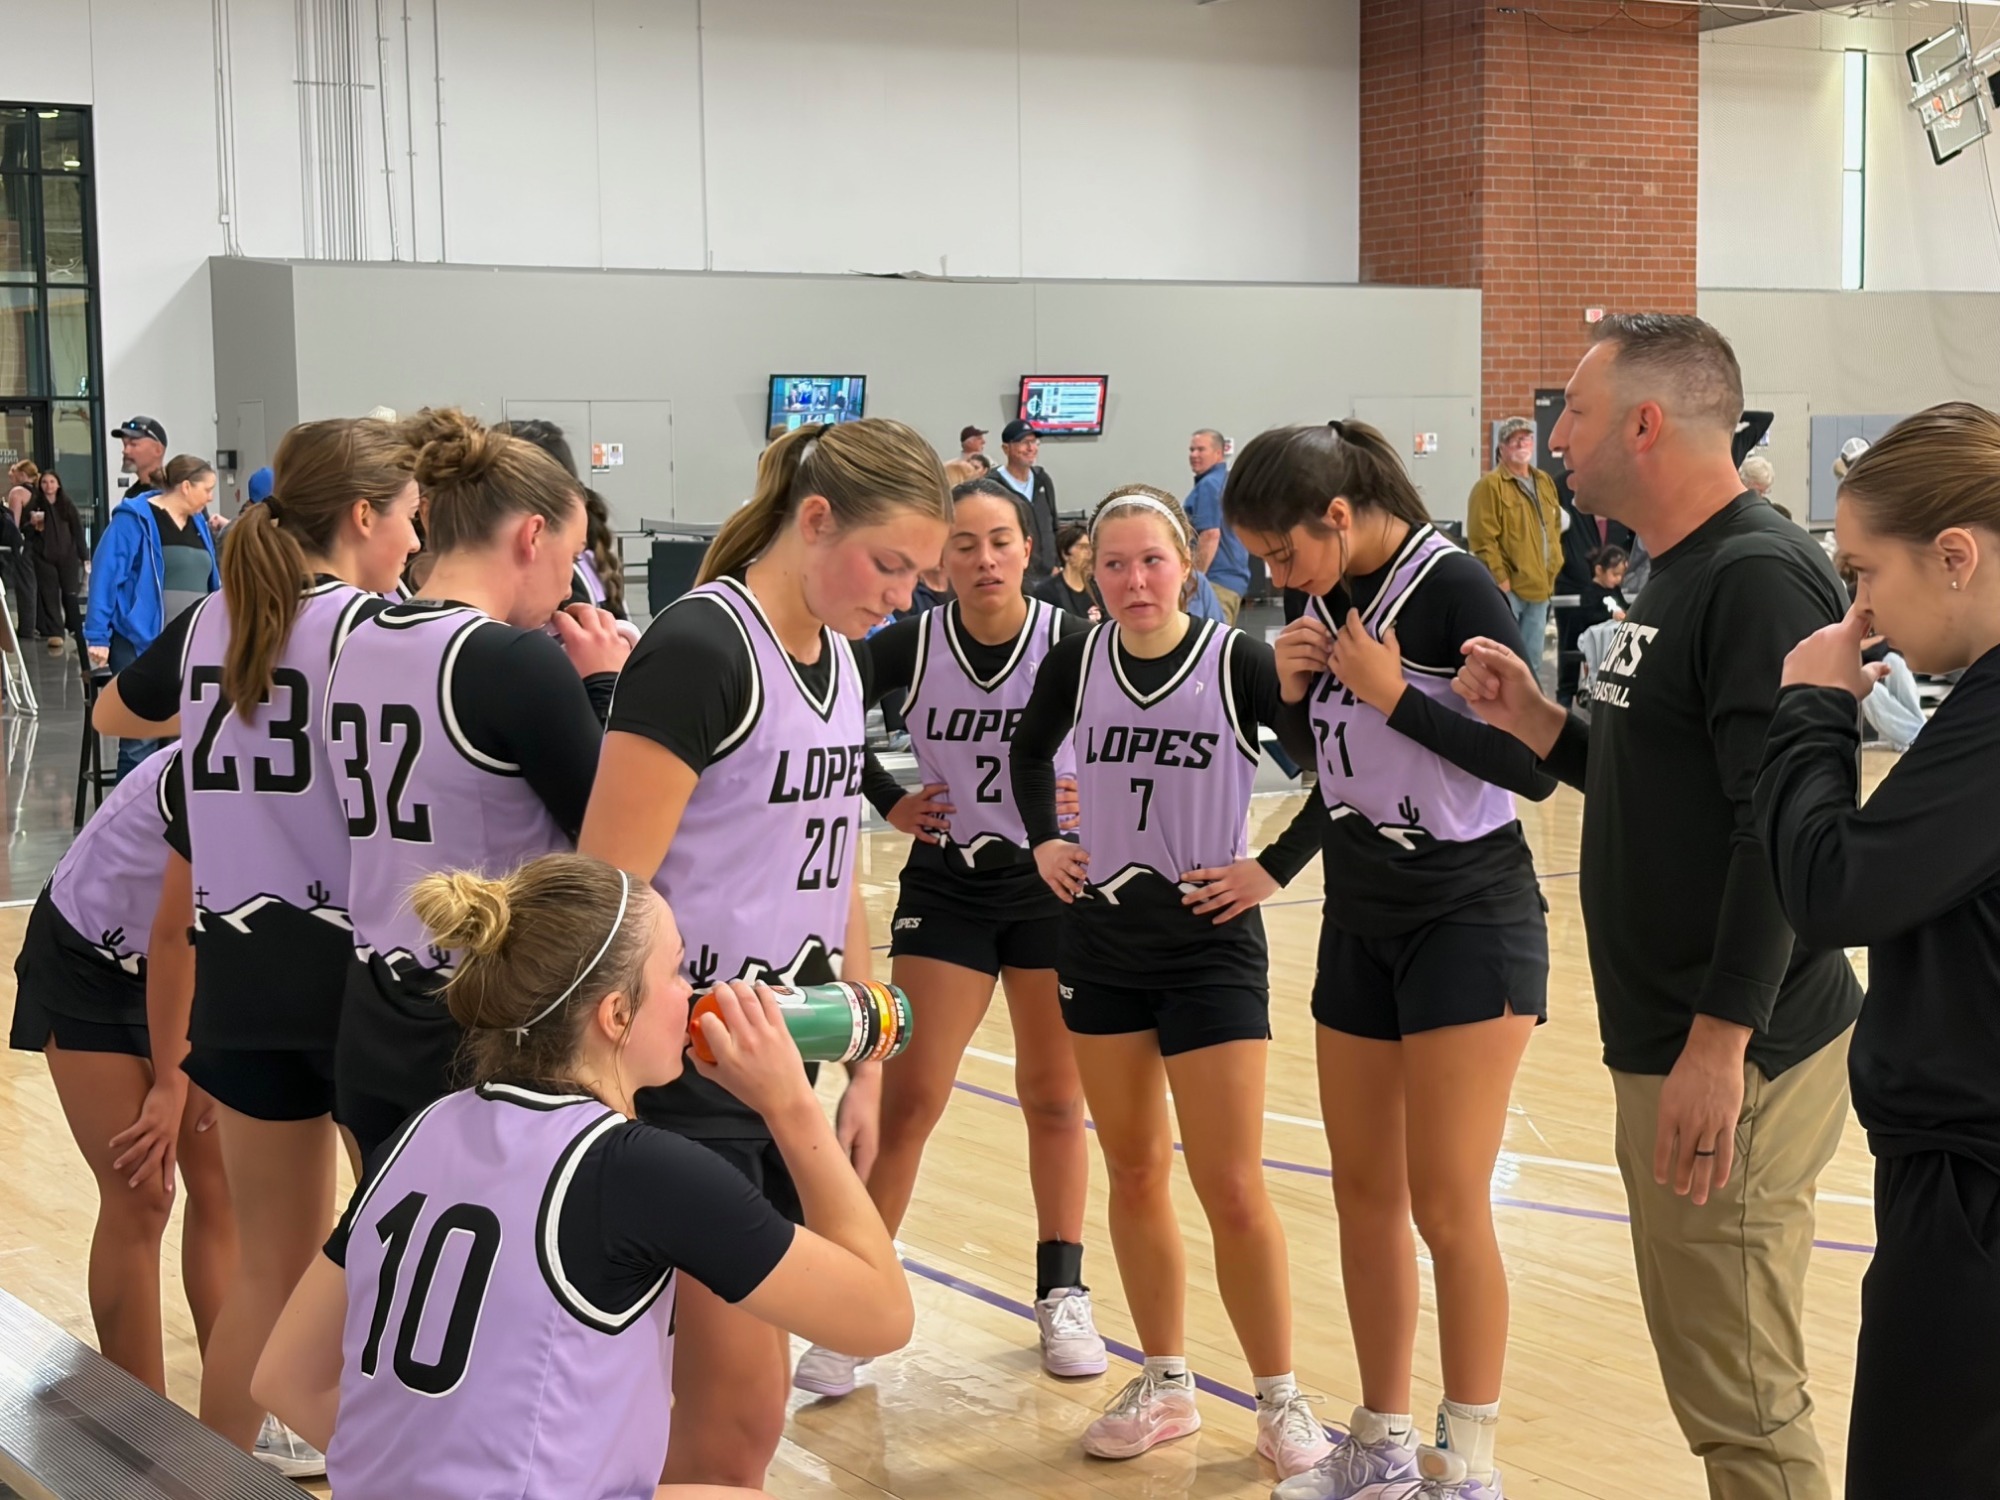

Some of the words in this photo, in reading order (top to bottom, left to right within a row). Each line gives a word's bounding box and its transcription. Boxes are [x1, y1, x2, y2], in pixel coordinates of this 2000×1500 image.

[190, 665, 315, 795] 23
[926, 707, 1026, 743] LOPE
[1086, 726, 1220, 770] LOPES
[332, 703, 434, 844] 32
[768, 745, 864, 804] LOPE
[976, 755, 1002, 803] 2
[1130, 777, 1154, 832] 7
[797, 816, 849, 891] 20
[361, 1190, 503, 1399] 10
